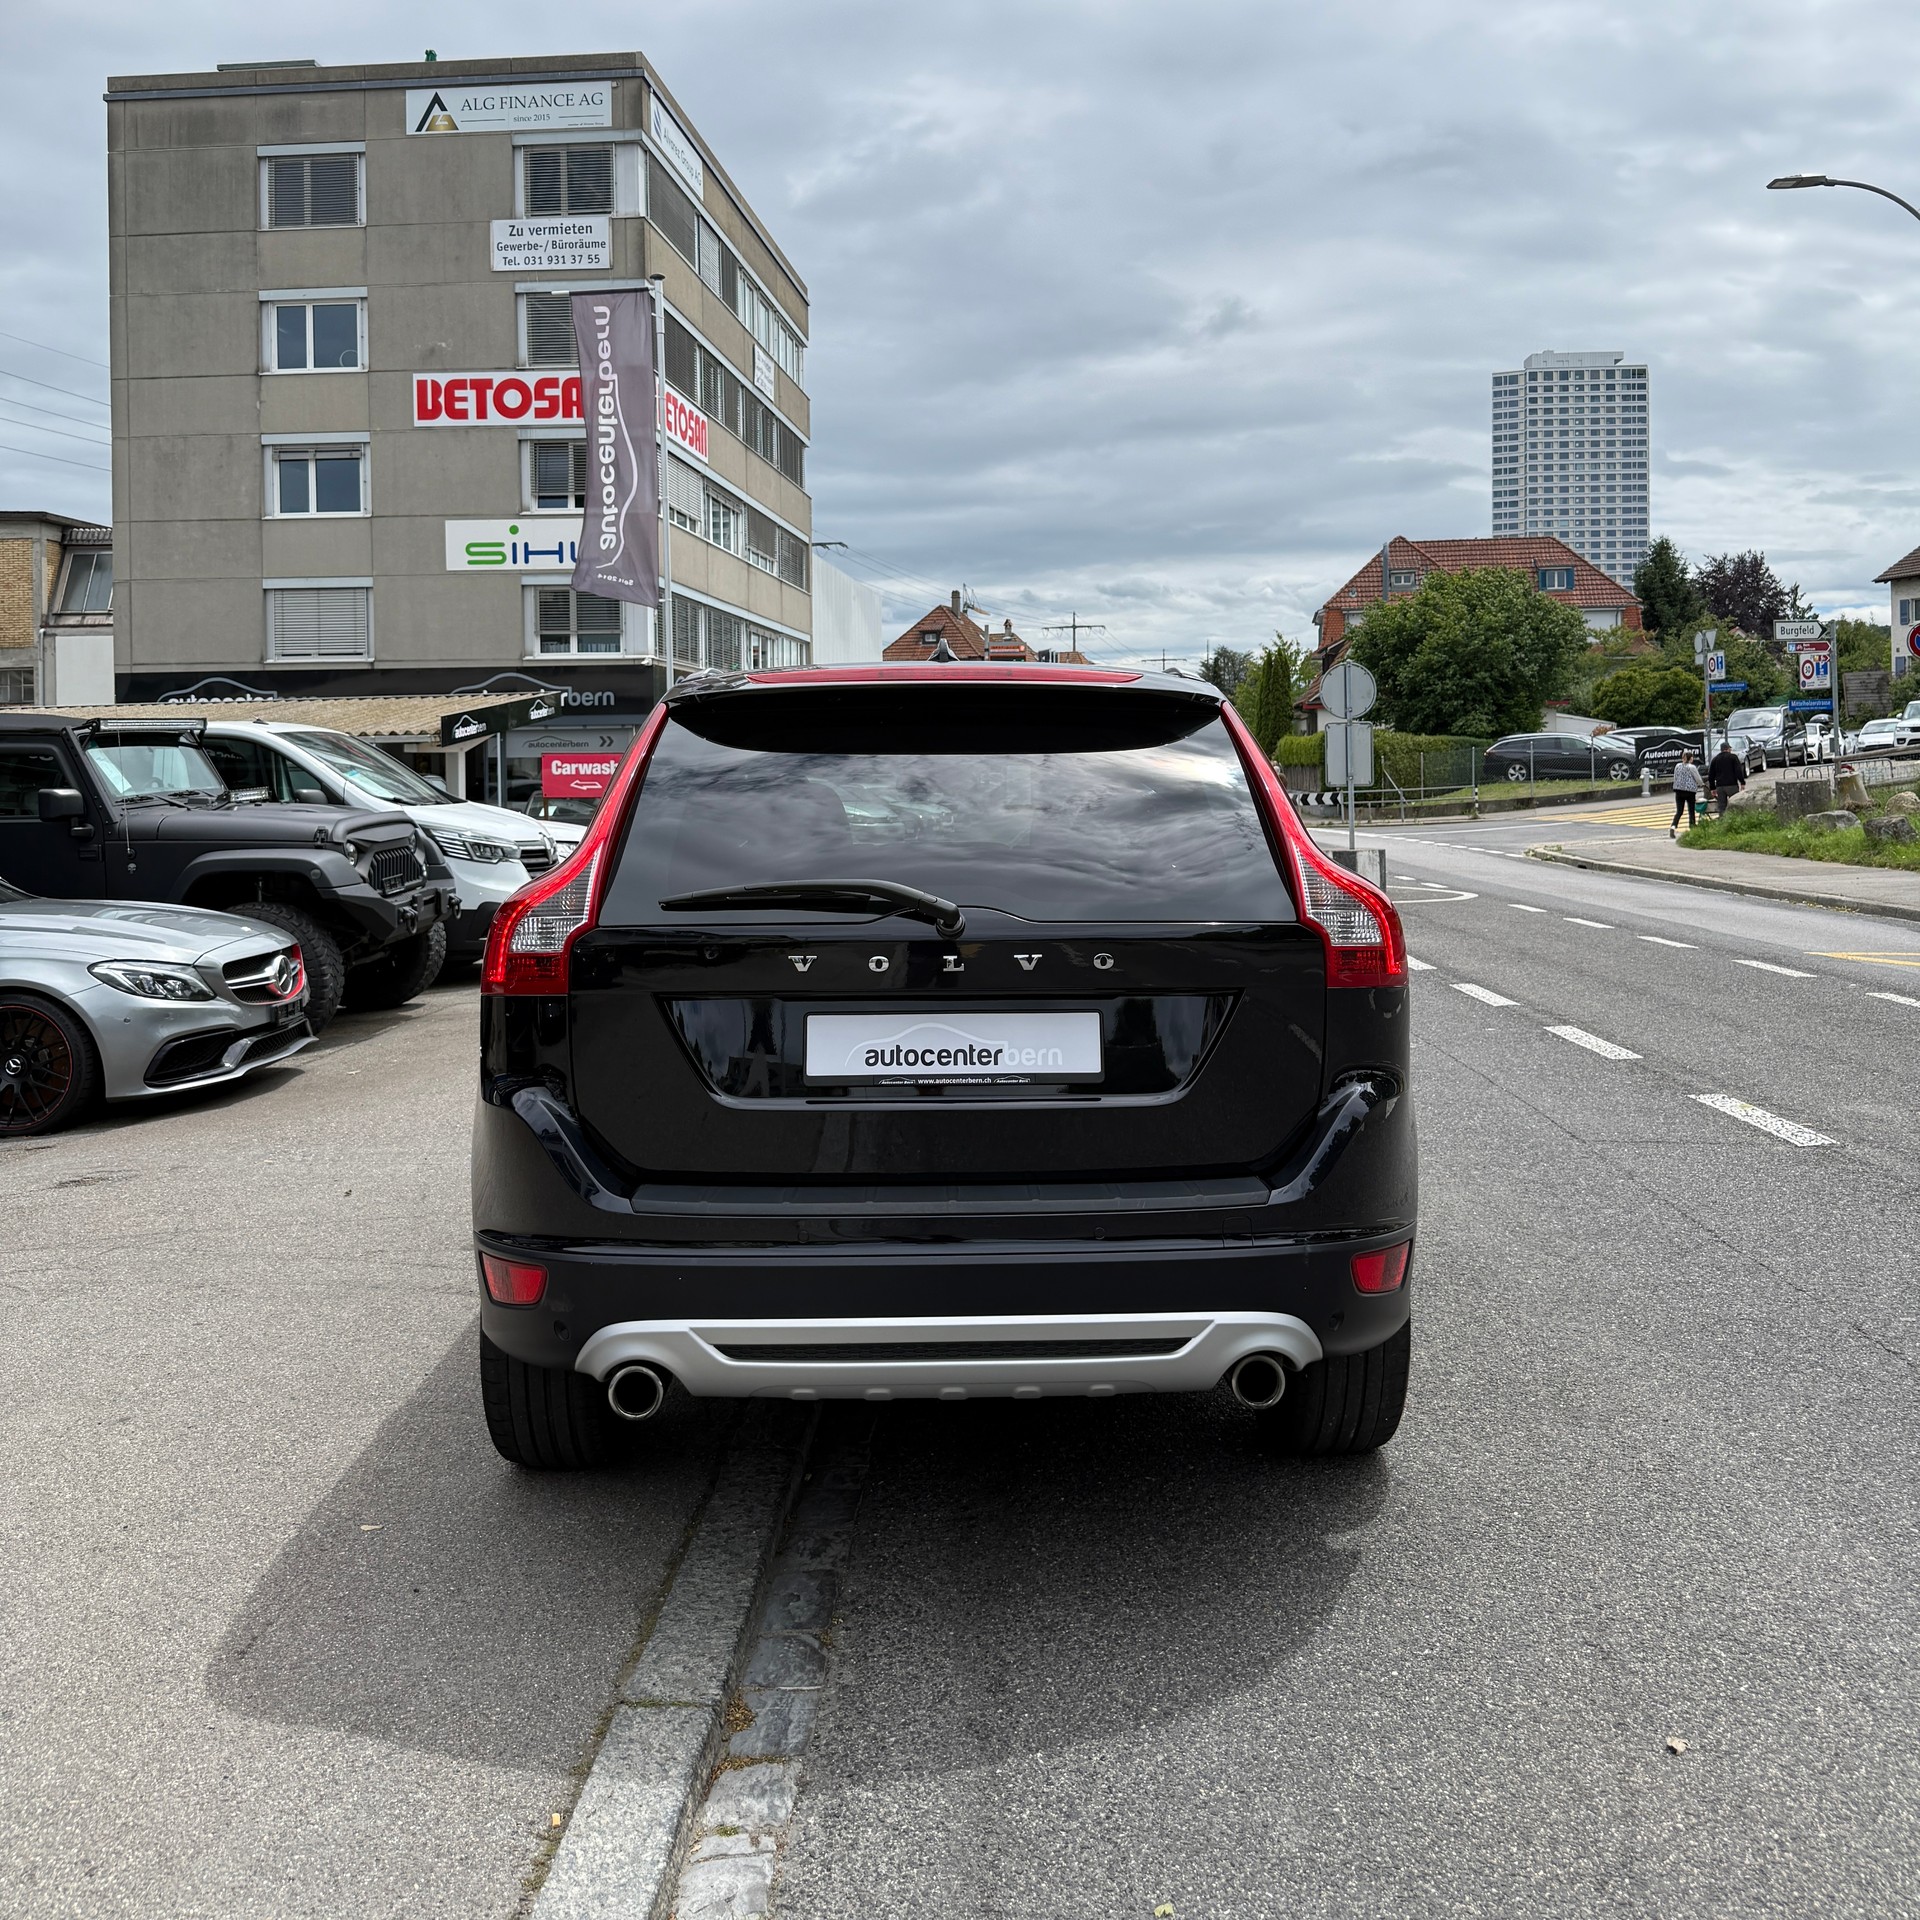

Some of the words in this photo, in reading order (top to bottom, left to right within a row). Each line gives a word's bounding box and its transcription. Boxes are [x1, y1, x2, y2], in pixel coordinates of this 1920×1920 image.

[461, 97, 495, 112] ALG
[500, 93, 575, 110] FINANCE
[579, 92, 604, 106] AG
[513, 115, 532, 123] since
[533, 113, 551, 122] 2015
[508, 224, 524, 237] Zu
[528, 222, 593, 236] vermieten
[502, 256, 520, 266] Tel.
[523, 256, 543, 266] 031
[547, 255, 566, 265] 931
[570, 254, 583, 264] 37
[587, 254, 601, 264] 55
[416, 376, 585, 421] BETOSA
[660, 386, 708, 458] ETOSAN
[1780, 625, 1815, 637] Burgfeld
[1644, 749, 1683, 760] Autocenter
[788, 953, 1115, 973] VOLVO
[864, 1043, 1063, 1067] autocenterbern
